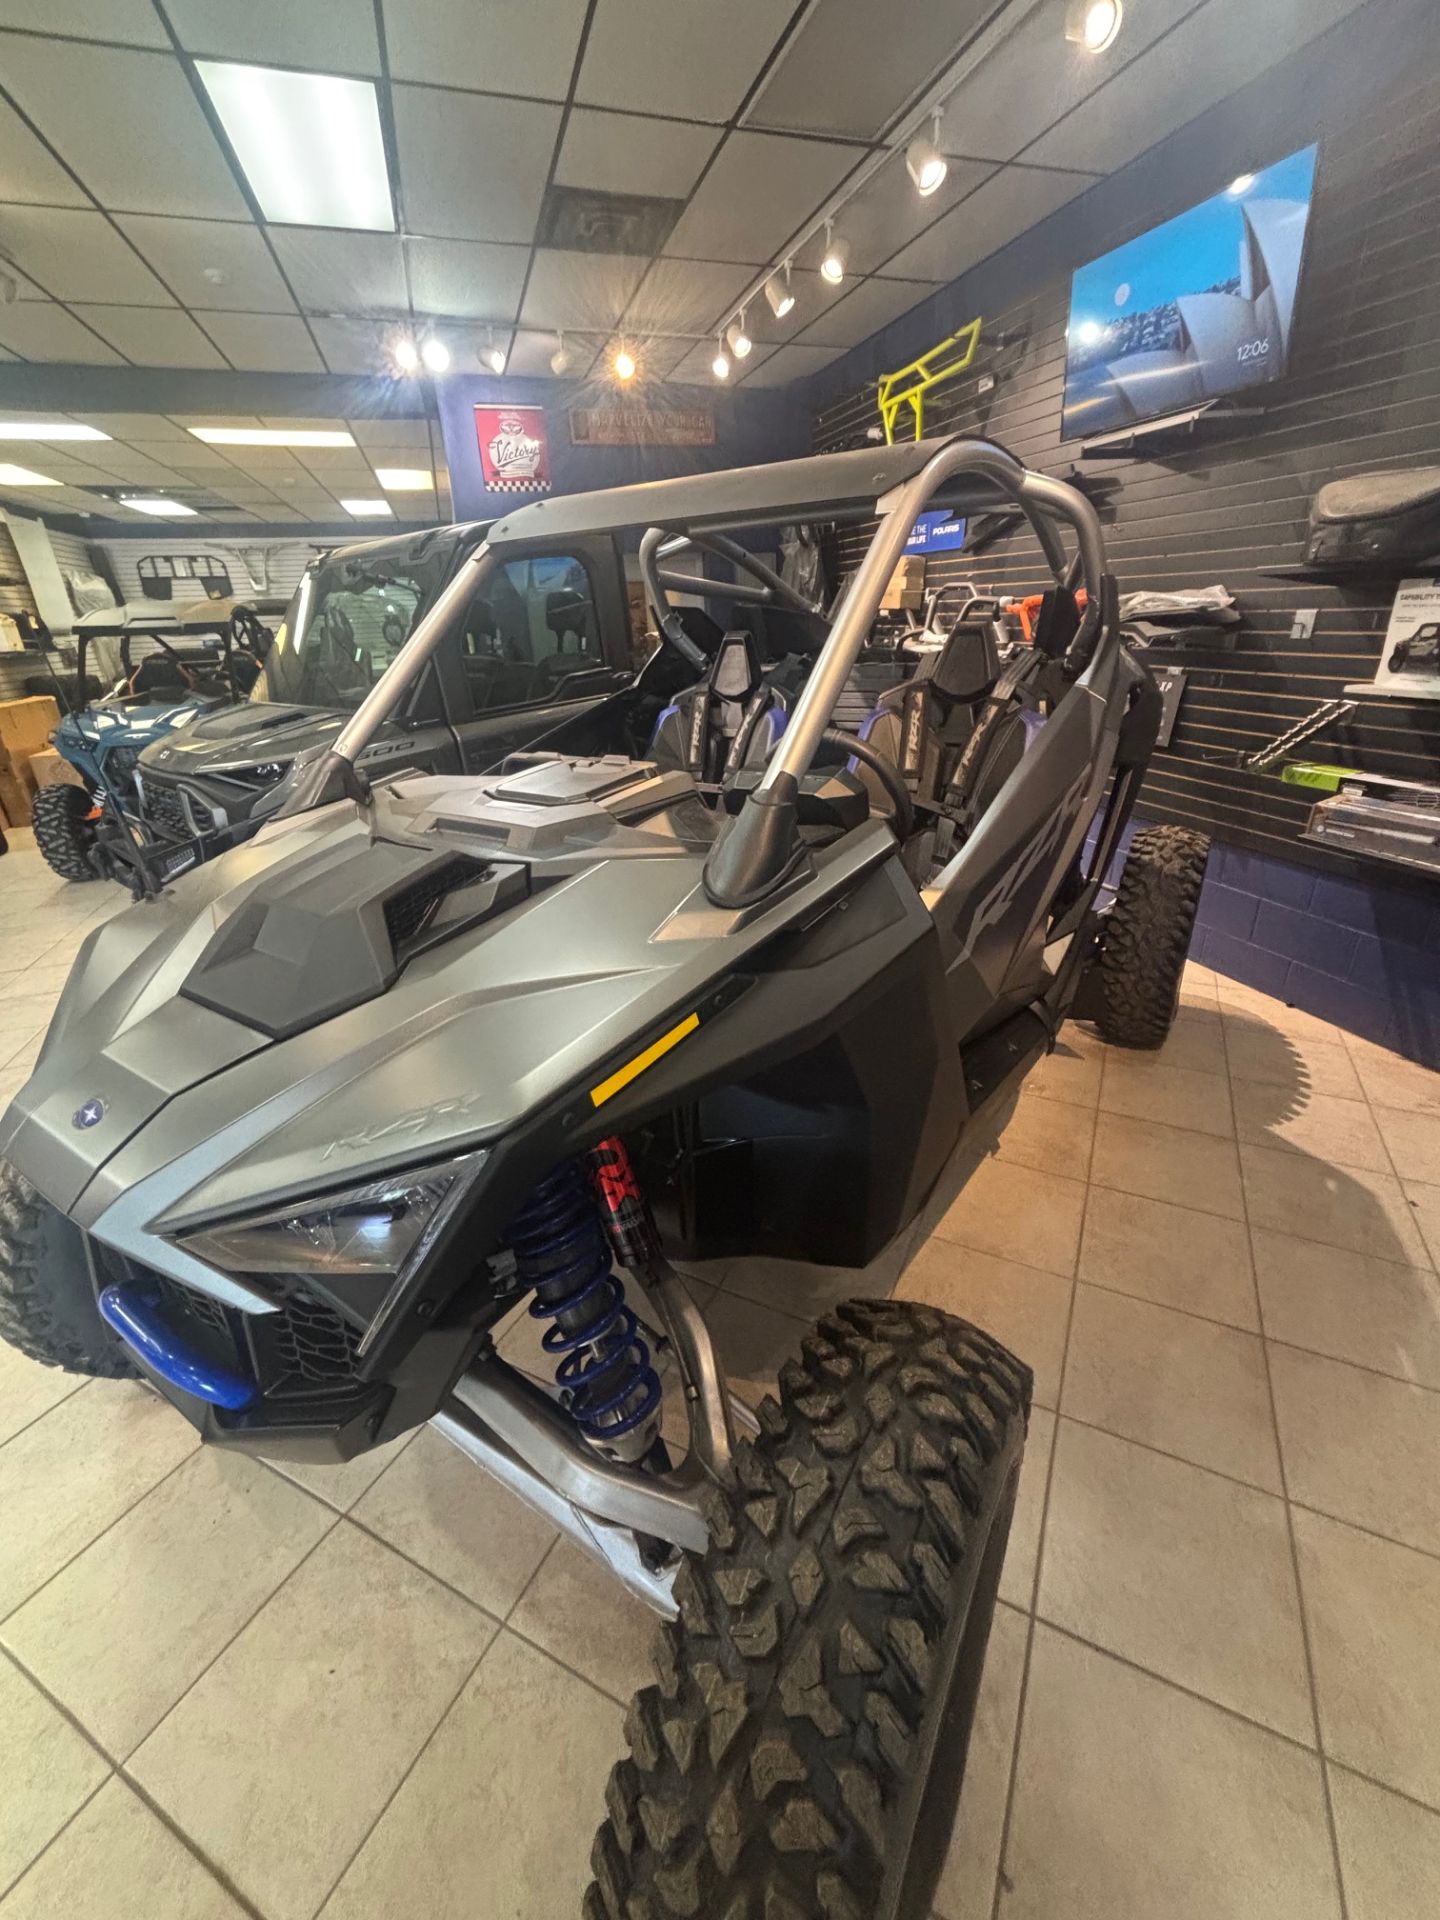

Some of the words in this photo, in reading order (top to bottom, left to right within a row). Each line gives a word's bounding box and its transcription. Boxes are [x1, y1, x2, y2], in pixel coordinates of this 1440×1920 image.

[1237, 338, 1269, 361] 12:06
[491, 439, 541, 466] Victory
[917, 524, 927, 534] THE
[932, 524, 960, 536] POLARIS
[916, 535, 927, 544] LIFE
